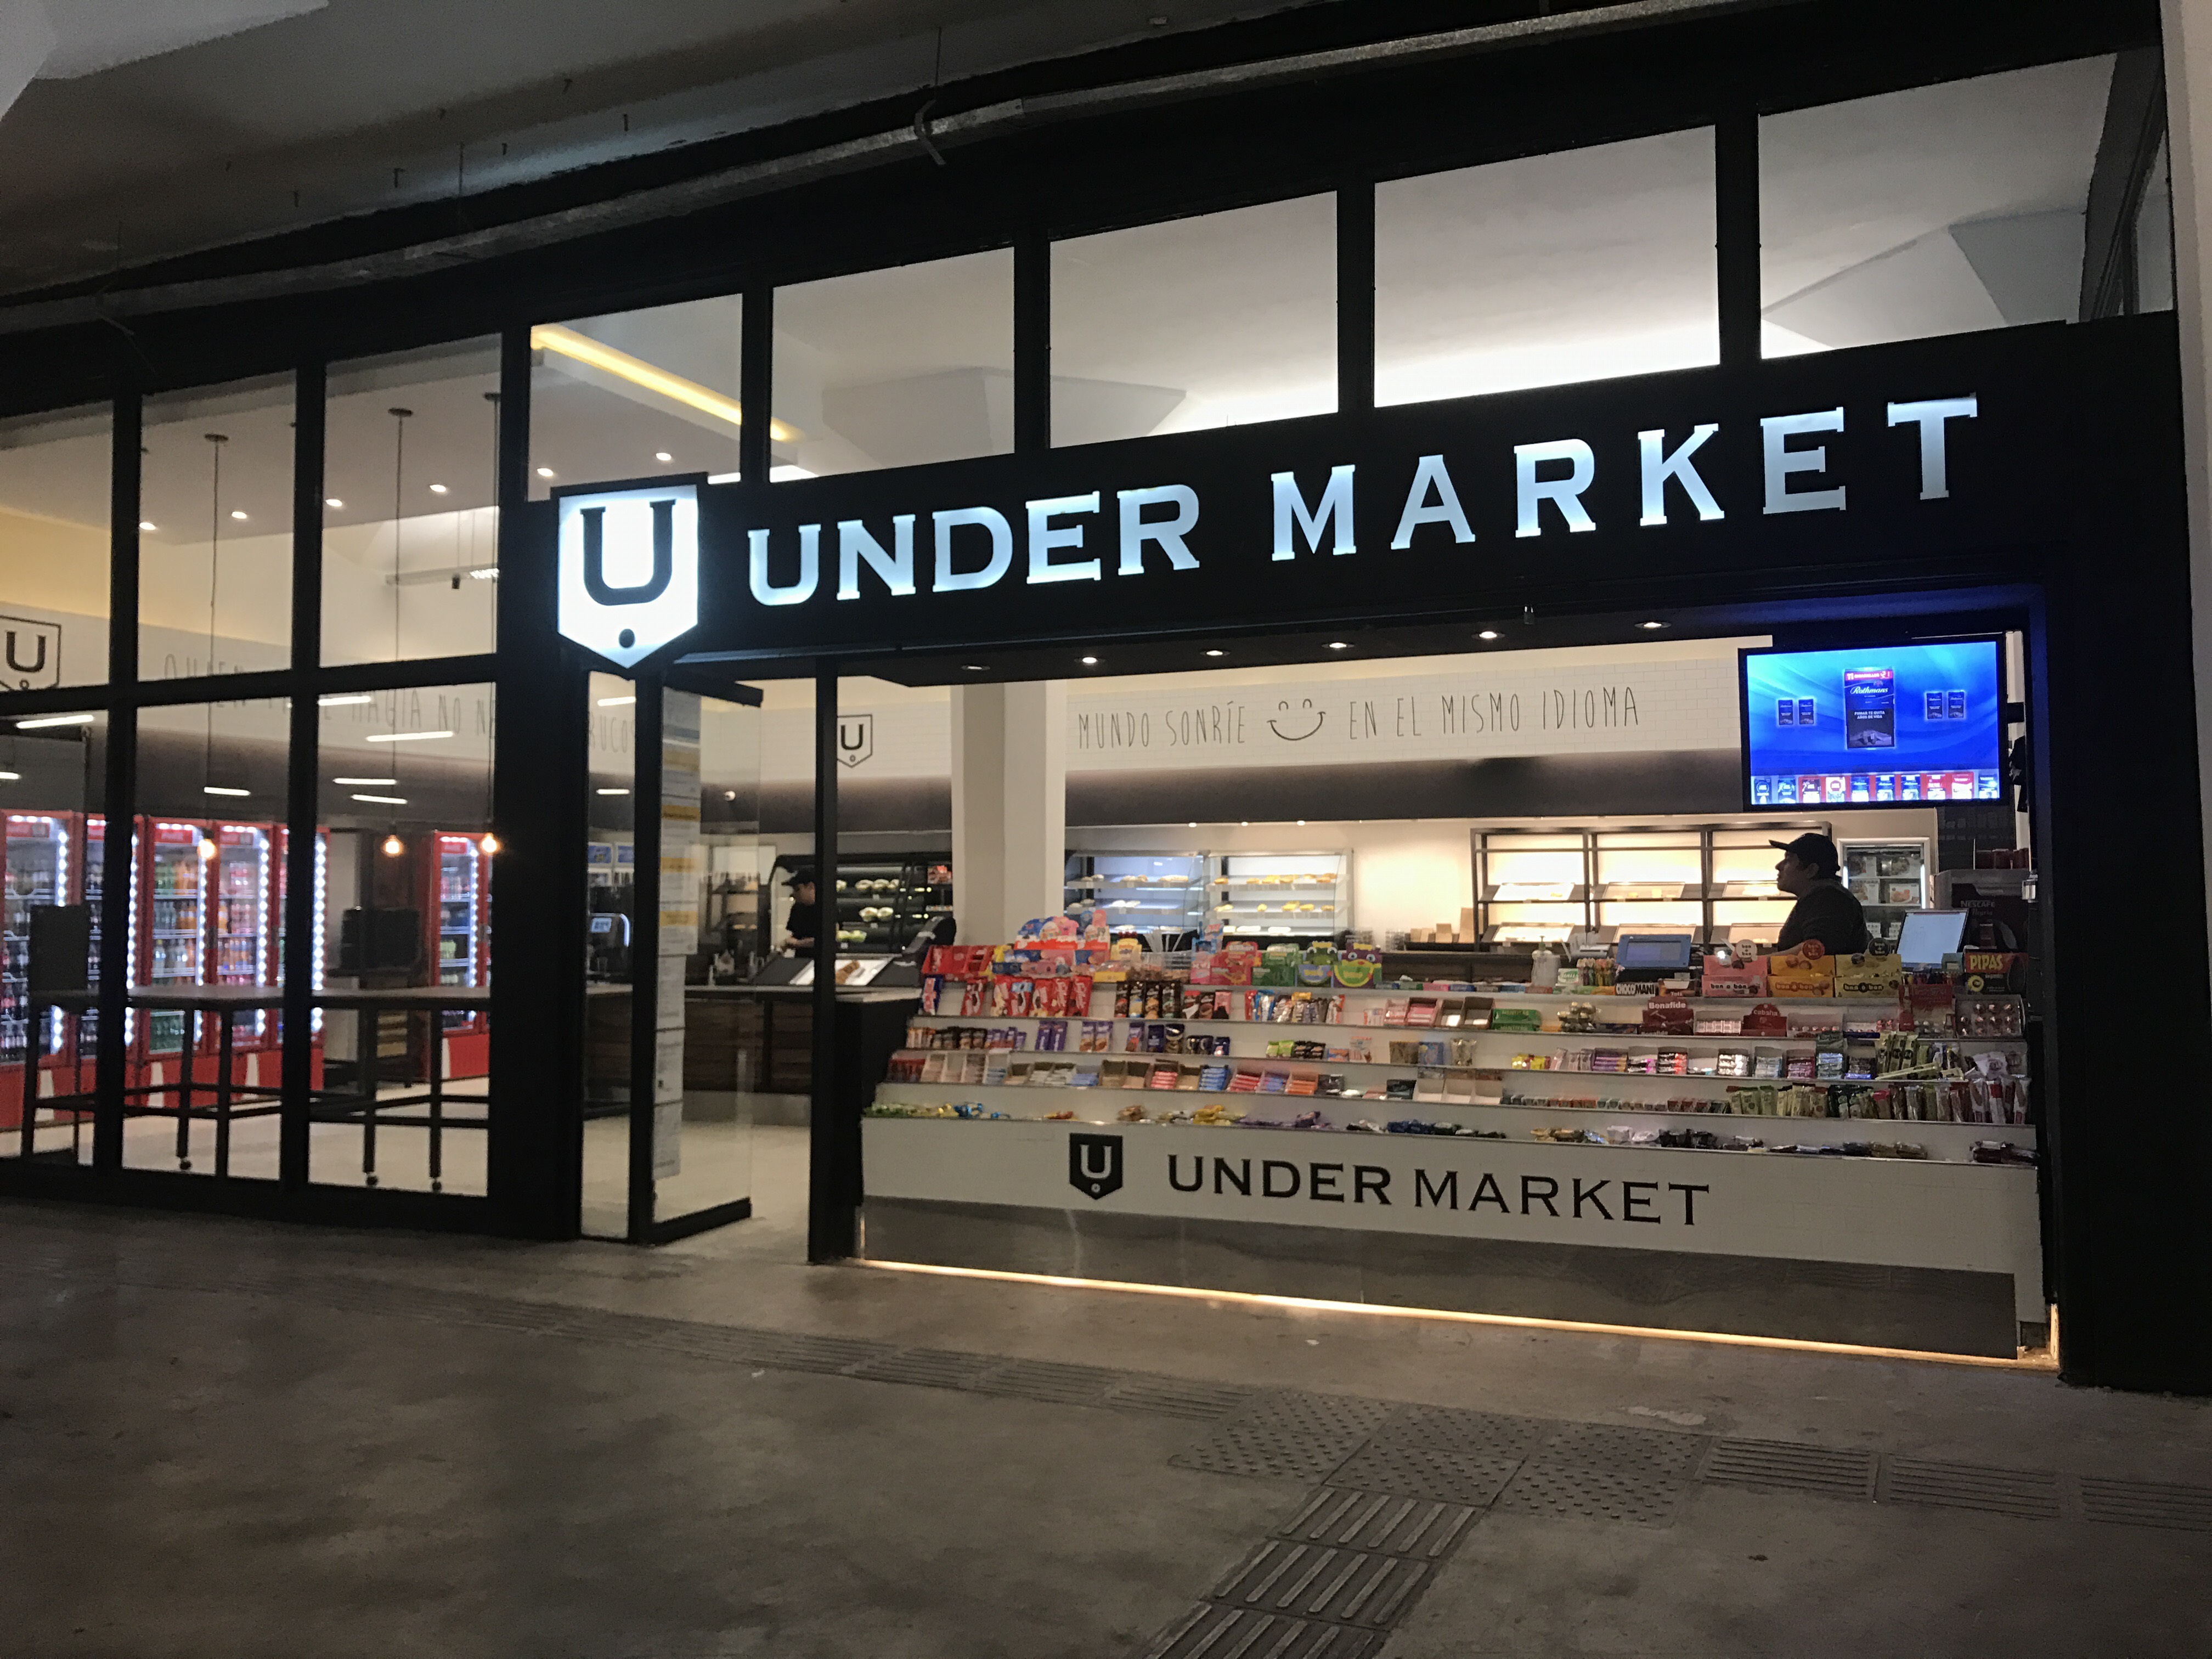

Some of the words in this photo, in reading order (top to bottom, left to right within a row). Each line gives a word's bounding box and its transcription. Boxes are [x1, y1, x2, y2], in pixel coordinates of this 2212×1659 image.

[747, 484, 1200, 607] UNDER
[1270, 396, 1978, 562] MARKET
[580, 499, 676, 606] U
[6, 631, 46, 673] U
[1079, 712, 1149, 749] MUNDO
[1165, 701, 1245, 747] SONRÍE
[1350, 701, 1376, 740] EN
[1397, 696, 1421, 736] EL
[1442, 692, 1519, 734] MISMO
[1543, 687, 1638, 730] IDIOMA
[840, 724, 865, 751] U
[1970, 955, 2004, 970] PIPAS
[1649, 1001, 1686, 1009] Bonafide
[1080, 1144, 1113, 1180] U
[1167, 1154, 1392, 1206] UNDER
[1414, 1168, 1710, 1227] MARKET
